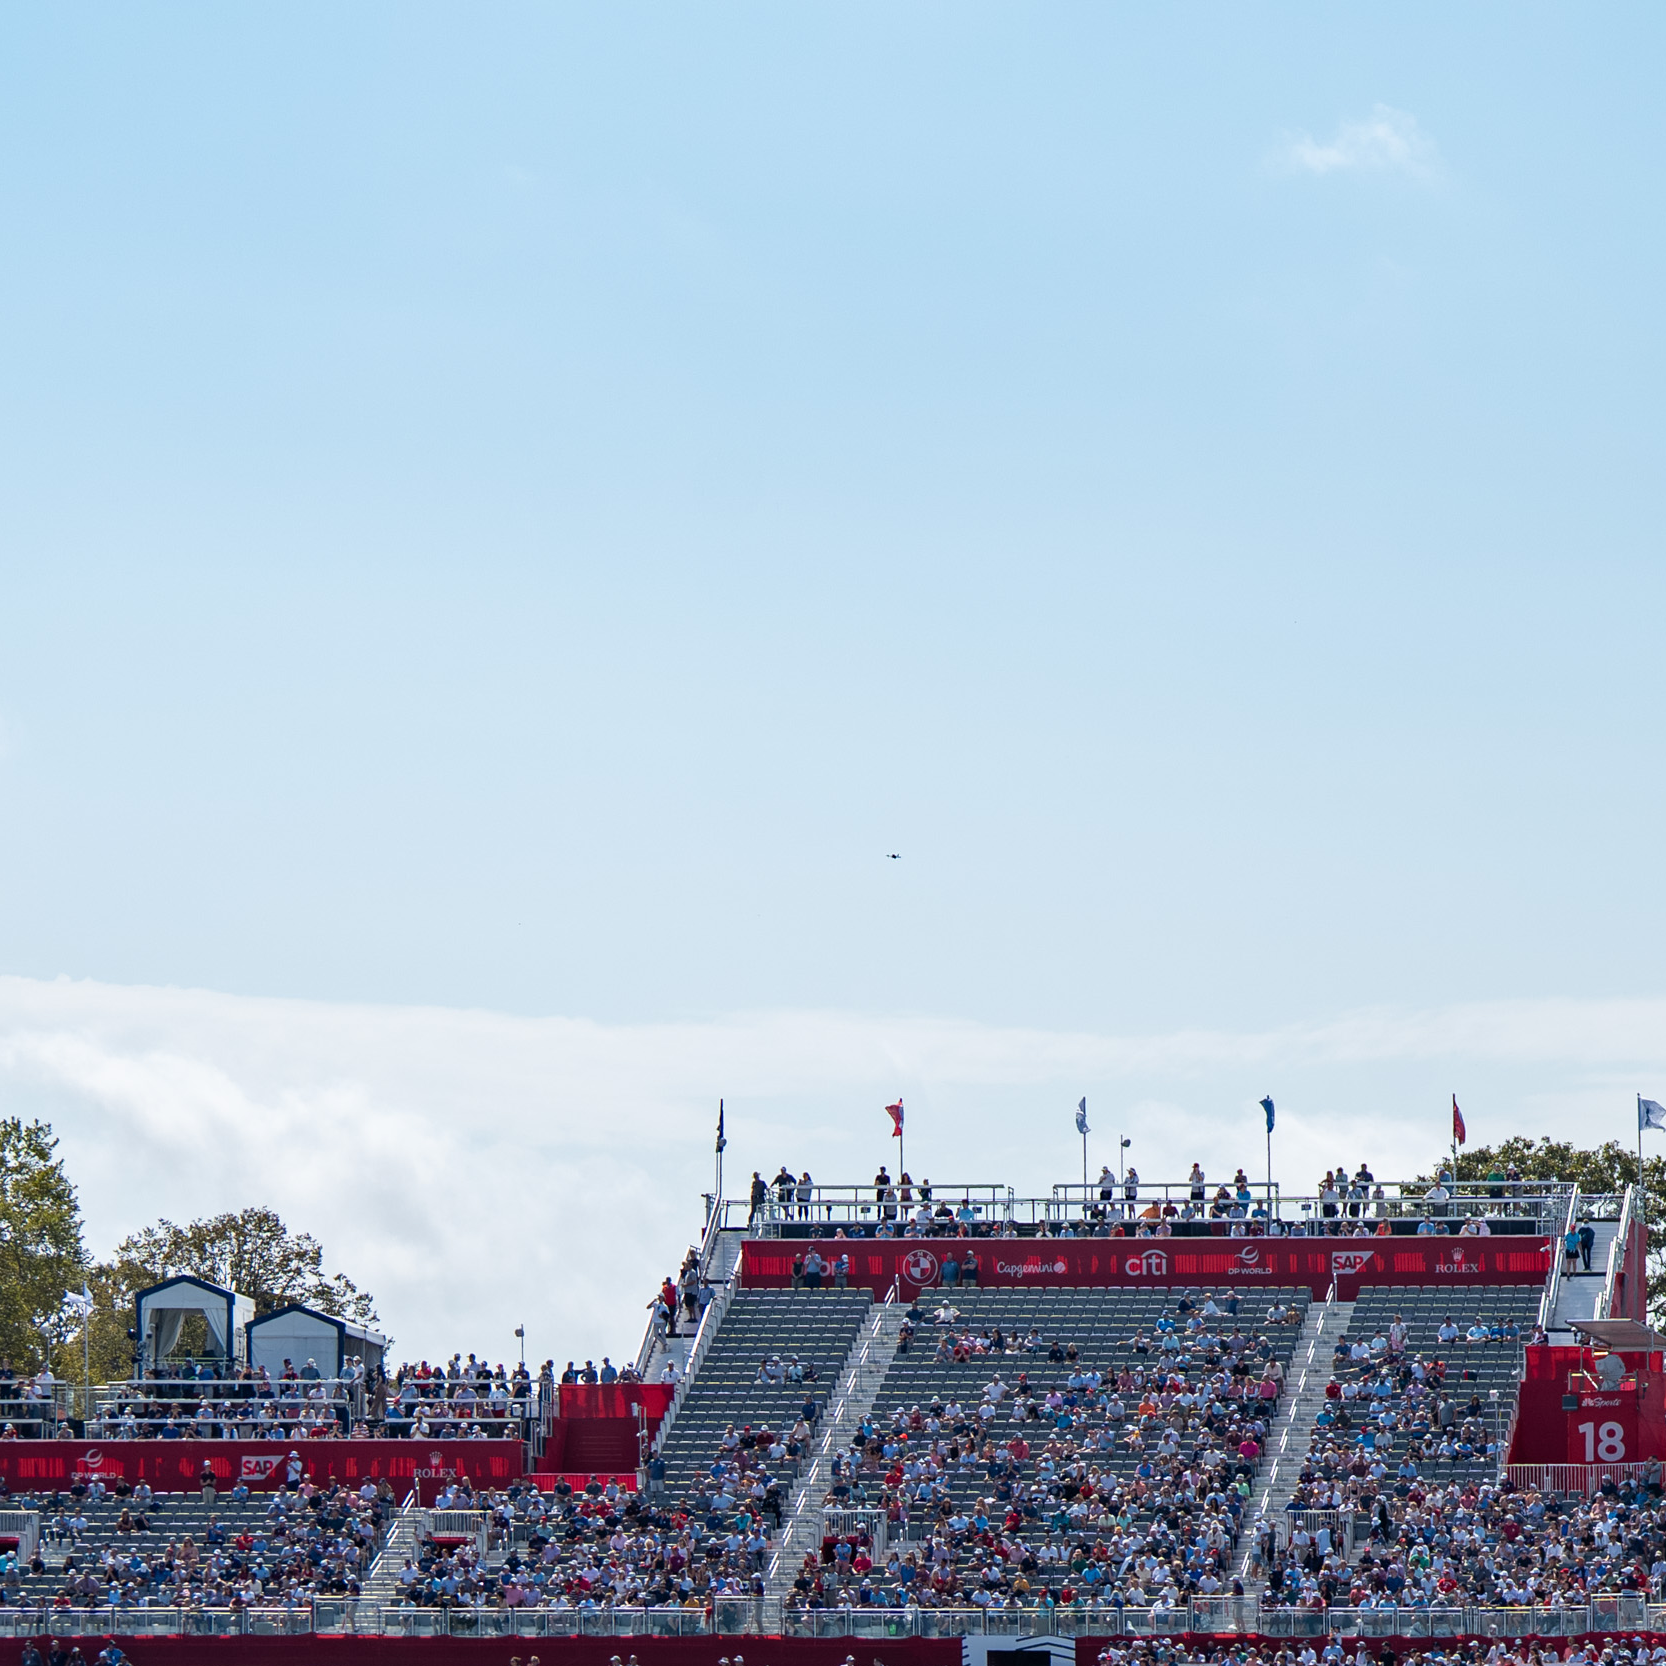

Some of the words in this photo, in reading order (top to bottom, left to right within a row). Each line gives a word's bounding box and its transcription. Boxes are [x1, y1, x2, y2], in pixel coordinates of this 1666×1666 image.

[997, 1261, 1053, 1278] Capgemini
[1125, 1250, 1168, 1276] citi
[1333, 1256, 1364, 1270] SAP
[1435, 1264, 1479, 1273] ROLEX
[1593, 1397, 1621, 1408] Sports
[1578, 1421, 1626, 1462] 18
[243, 1460, 273, 1476] SAP
[413, 1468, 457, 1478] ROLEX
